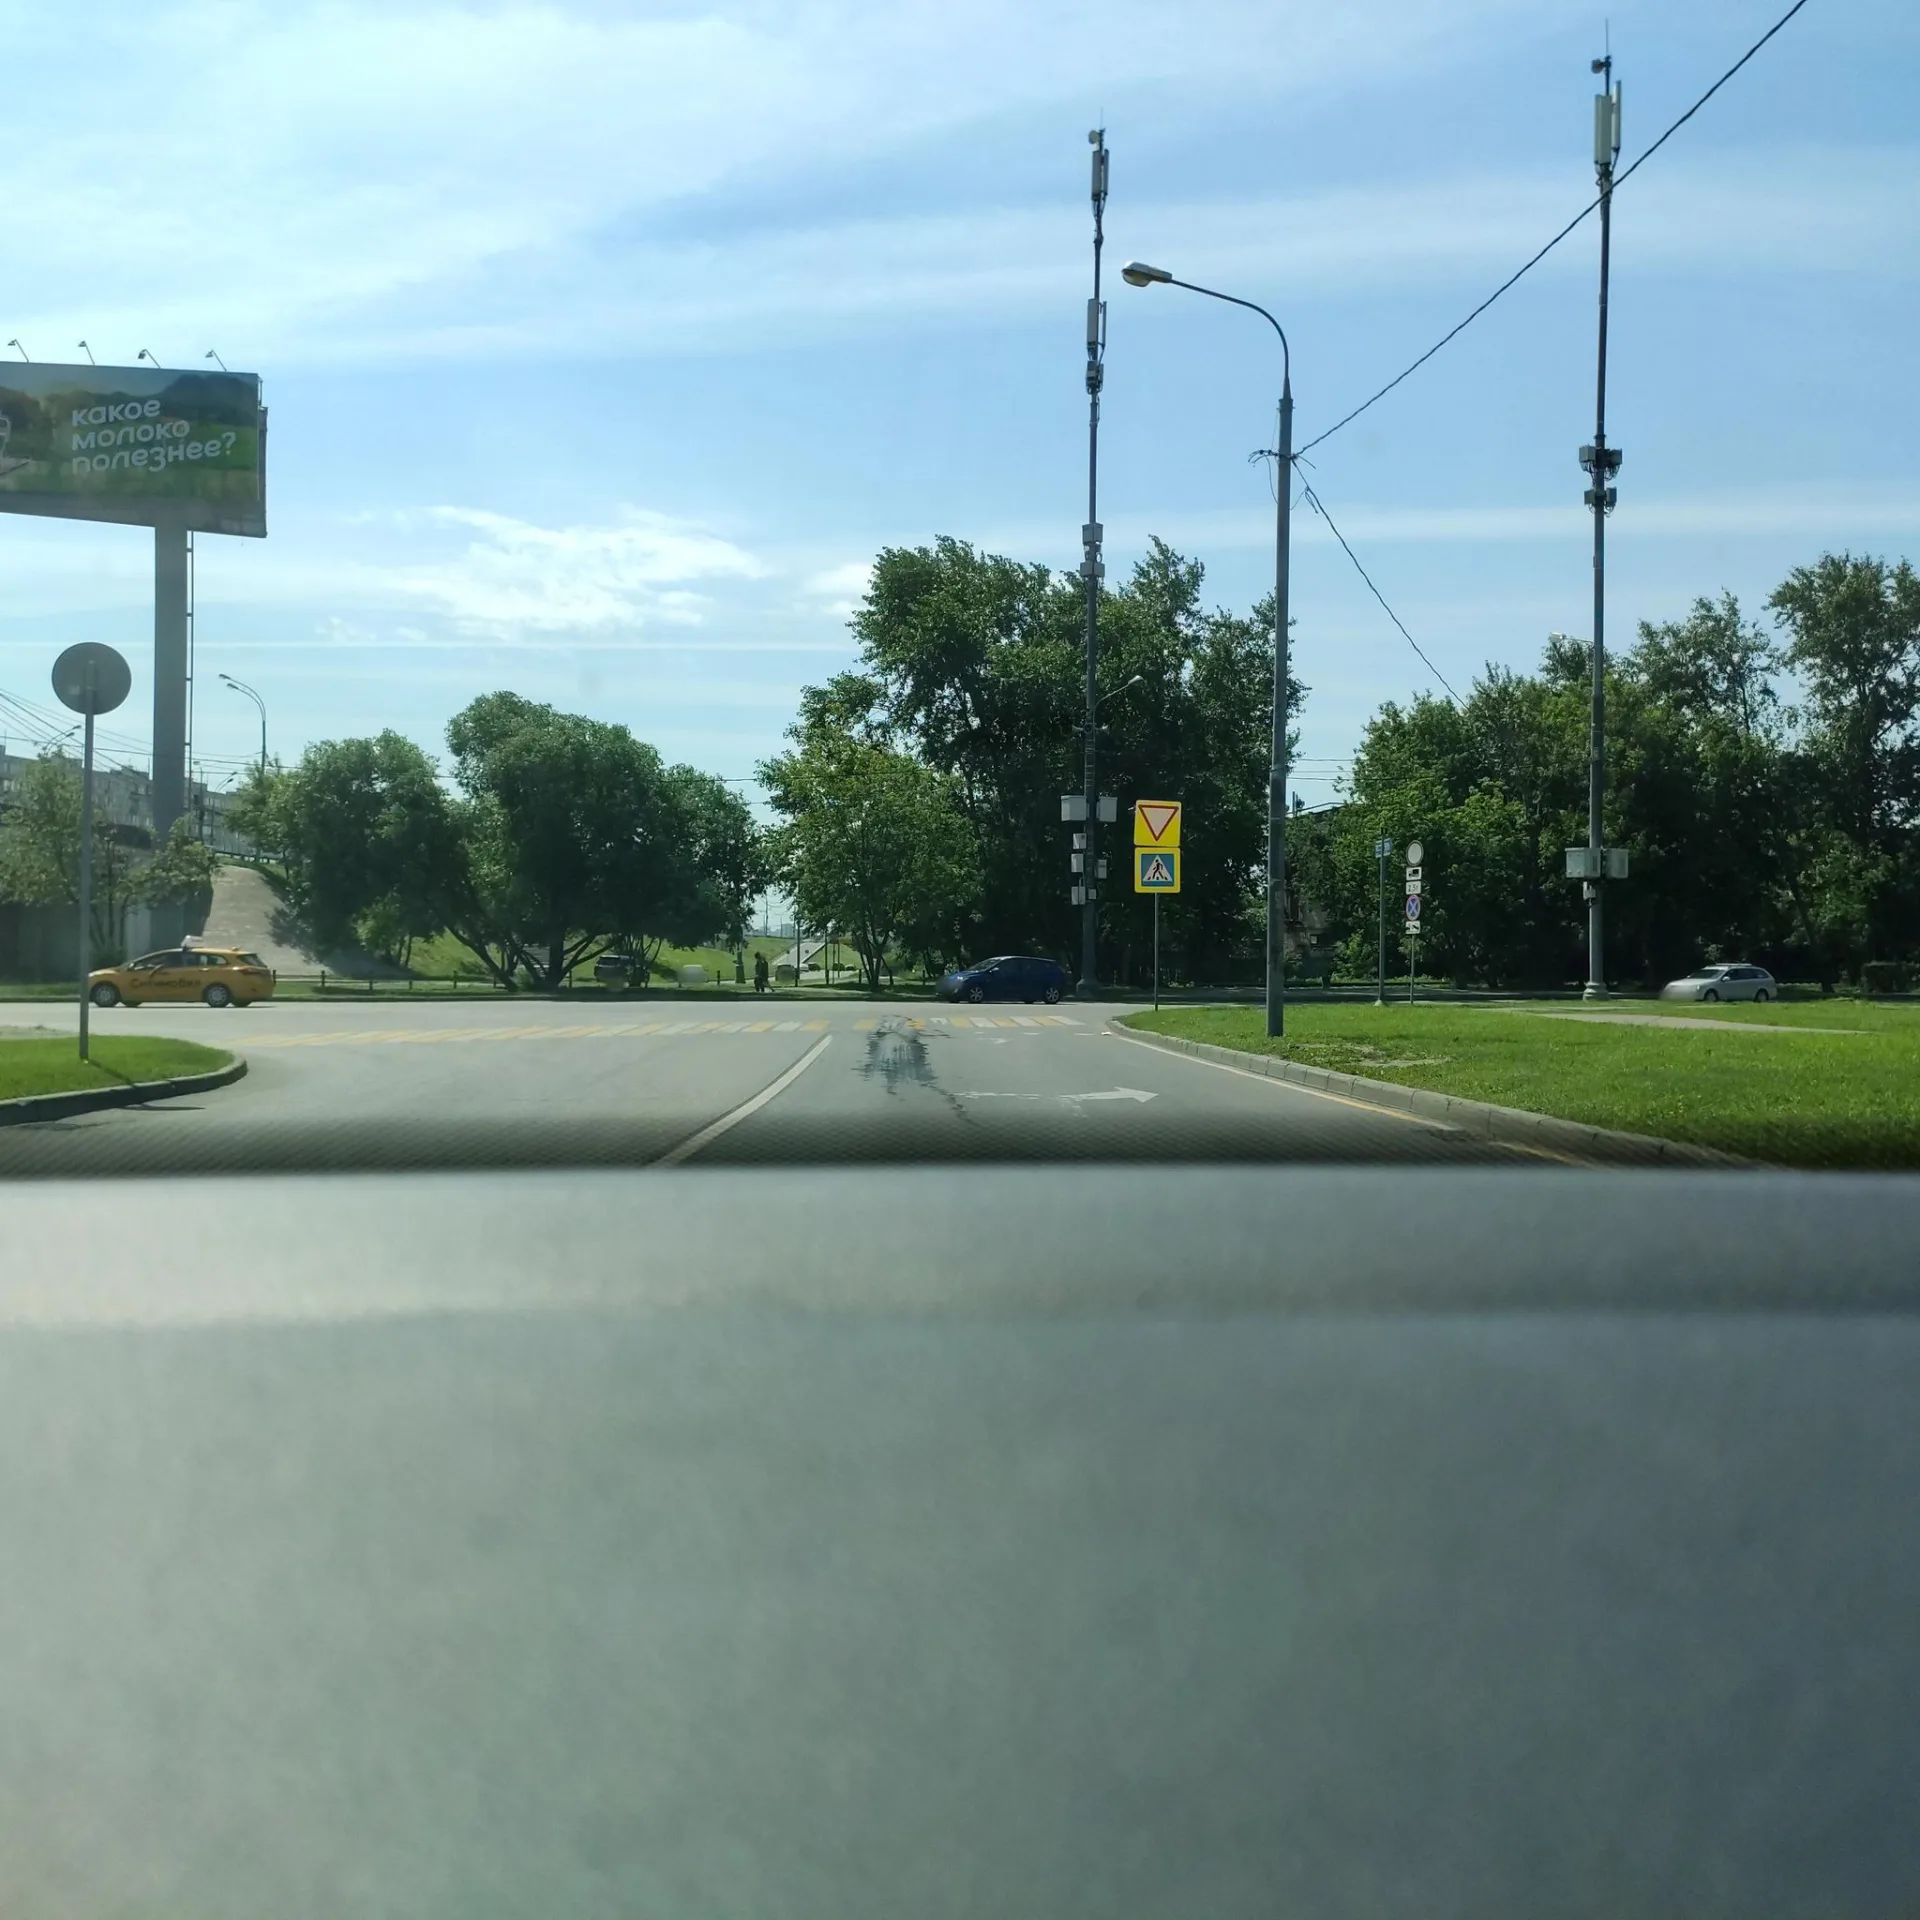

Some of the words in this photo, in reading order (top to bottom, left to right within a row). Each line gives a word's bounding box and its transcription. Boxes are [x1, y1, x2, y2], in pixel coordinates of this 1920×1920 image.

[72, 399, 161, 427] какое
[72, 420, 190, 451] молоко
[72, 432, 237, 473] полезнее?
